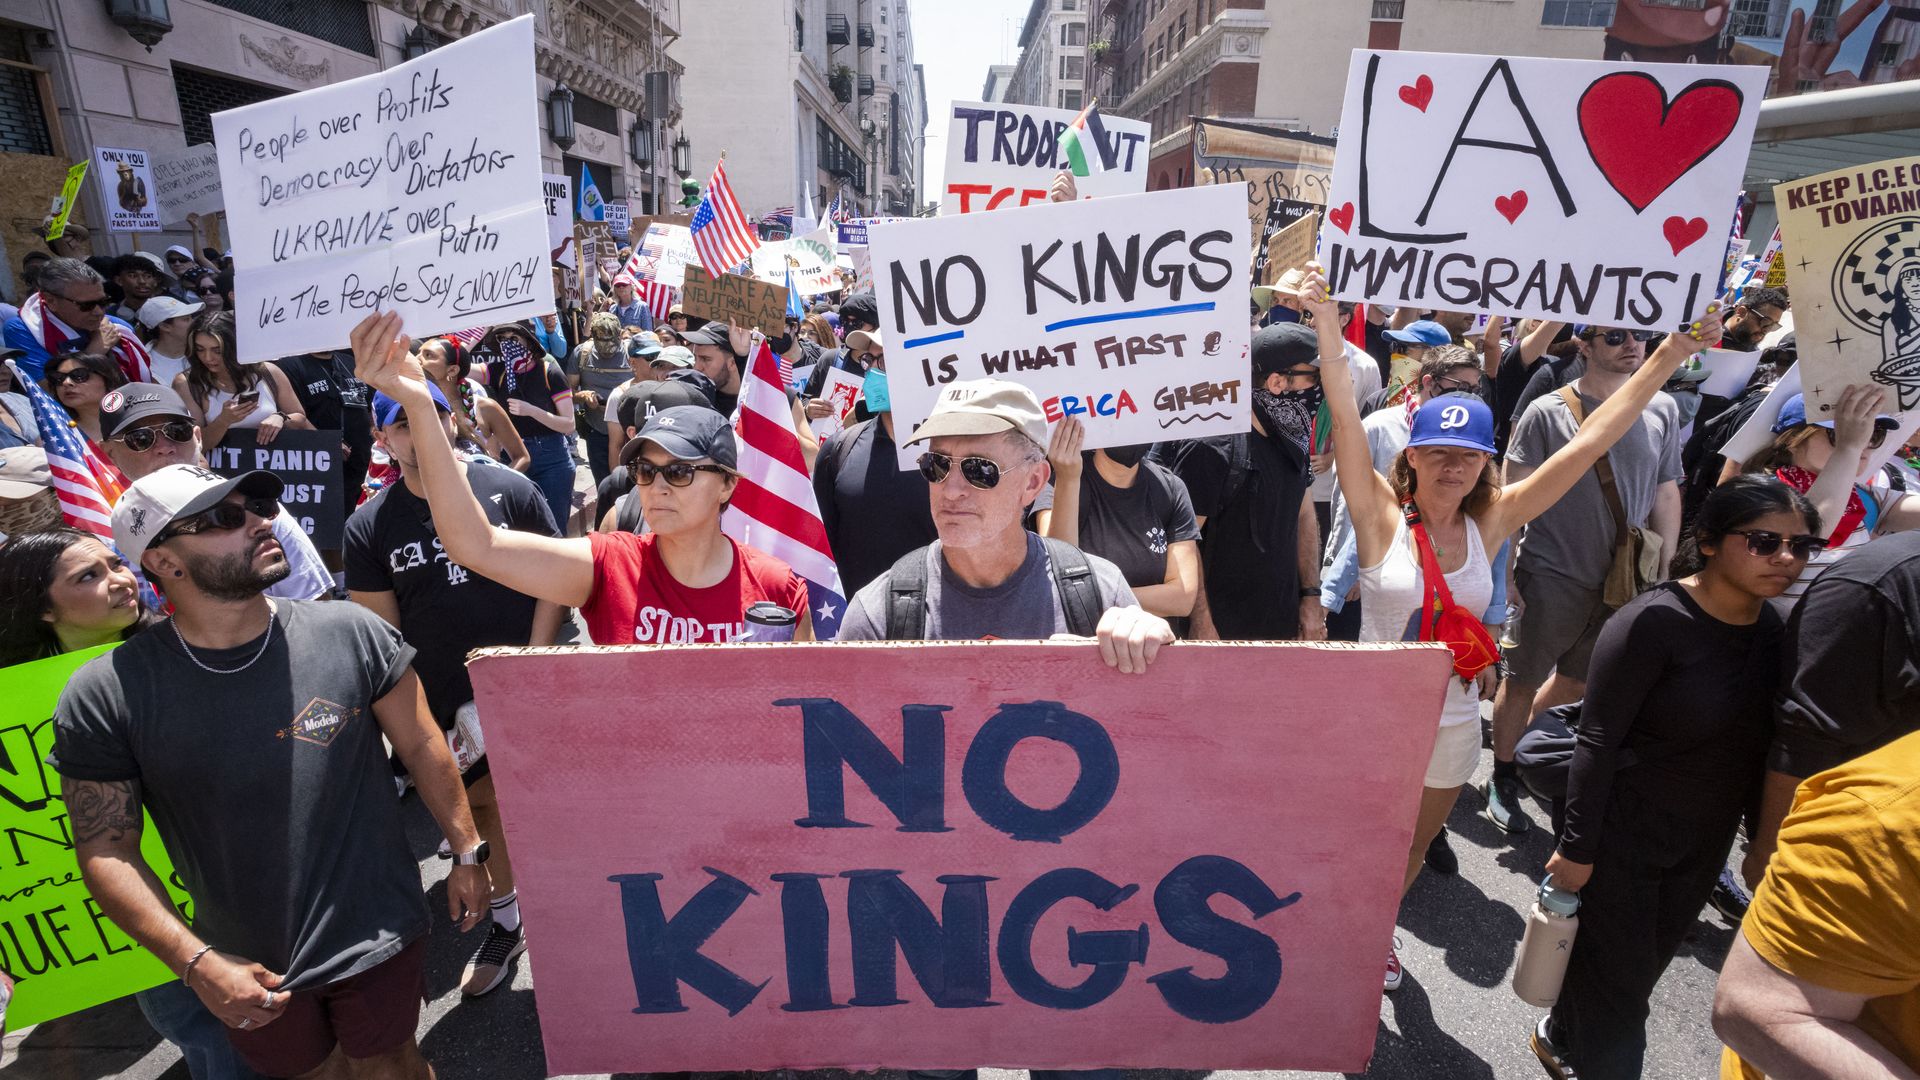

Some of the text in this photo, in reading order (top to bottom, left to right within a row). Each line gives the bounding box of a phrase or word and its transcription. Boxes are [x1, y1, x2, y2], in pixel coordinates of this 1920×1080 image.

[238, 68, 453, 165] People over Profits
[102, 150, 144, 164] ONLY YOU
[954, 107, 1145, 172] TROOP UT
[154, 160, 180, 180] OPLE
[259, 132, 434, 206] Democracy Over
[404, 137, 514, 196] Dictators
[1274, 199, 1284, 214] I
[1286, 206, 1303, 216] was
[1786, 176, 1850, 210] KEEP
[1856, 165, 1906, 195] I.C.E
[1816, 188, 1920, 228] TOVAAN
[272, 202, 455, 262] UKRAINE over
[439, 215, 498, 256] Putin
[687, 267, 776, 303] I HATE A
[800, 266, 822, 275] THIS
[890, 254, 986, 334] NO
[1022, 230, 1233, 315] KINGS
[1329, 243, 1702, 333] IMMIGRANTS!
[259, 256, 540, 328] We The People Say ENOUGH
[758, 303, 785, 320] ASS
[710, 306, 766, 332] BITCH
[922, 353, 958, 386] IS
[981, 342, 1078, 376] WHAT
[1094, 334, 1188, 370] FIRST
[659, 417, 675, 426] OR
[1044, 380, 1240, 424] ERICA GREAT
[1440, 405, 1470, 430] D
[206, 446, 331, 472] N'T PANIC
[281, 484, 325, 503] UST
[445, 561, 470, 586] LA
[635, 605, 742, 644] STOP TH
[304, 714, 339, 731] Modelo
[772, 697, 1120, 844] NO
[606, 853, 1303, 1025] KINGS
